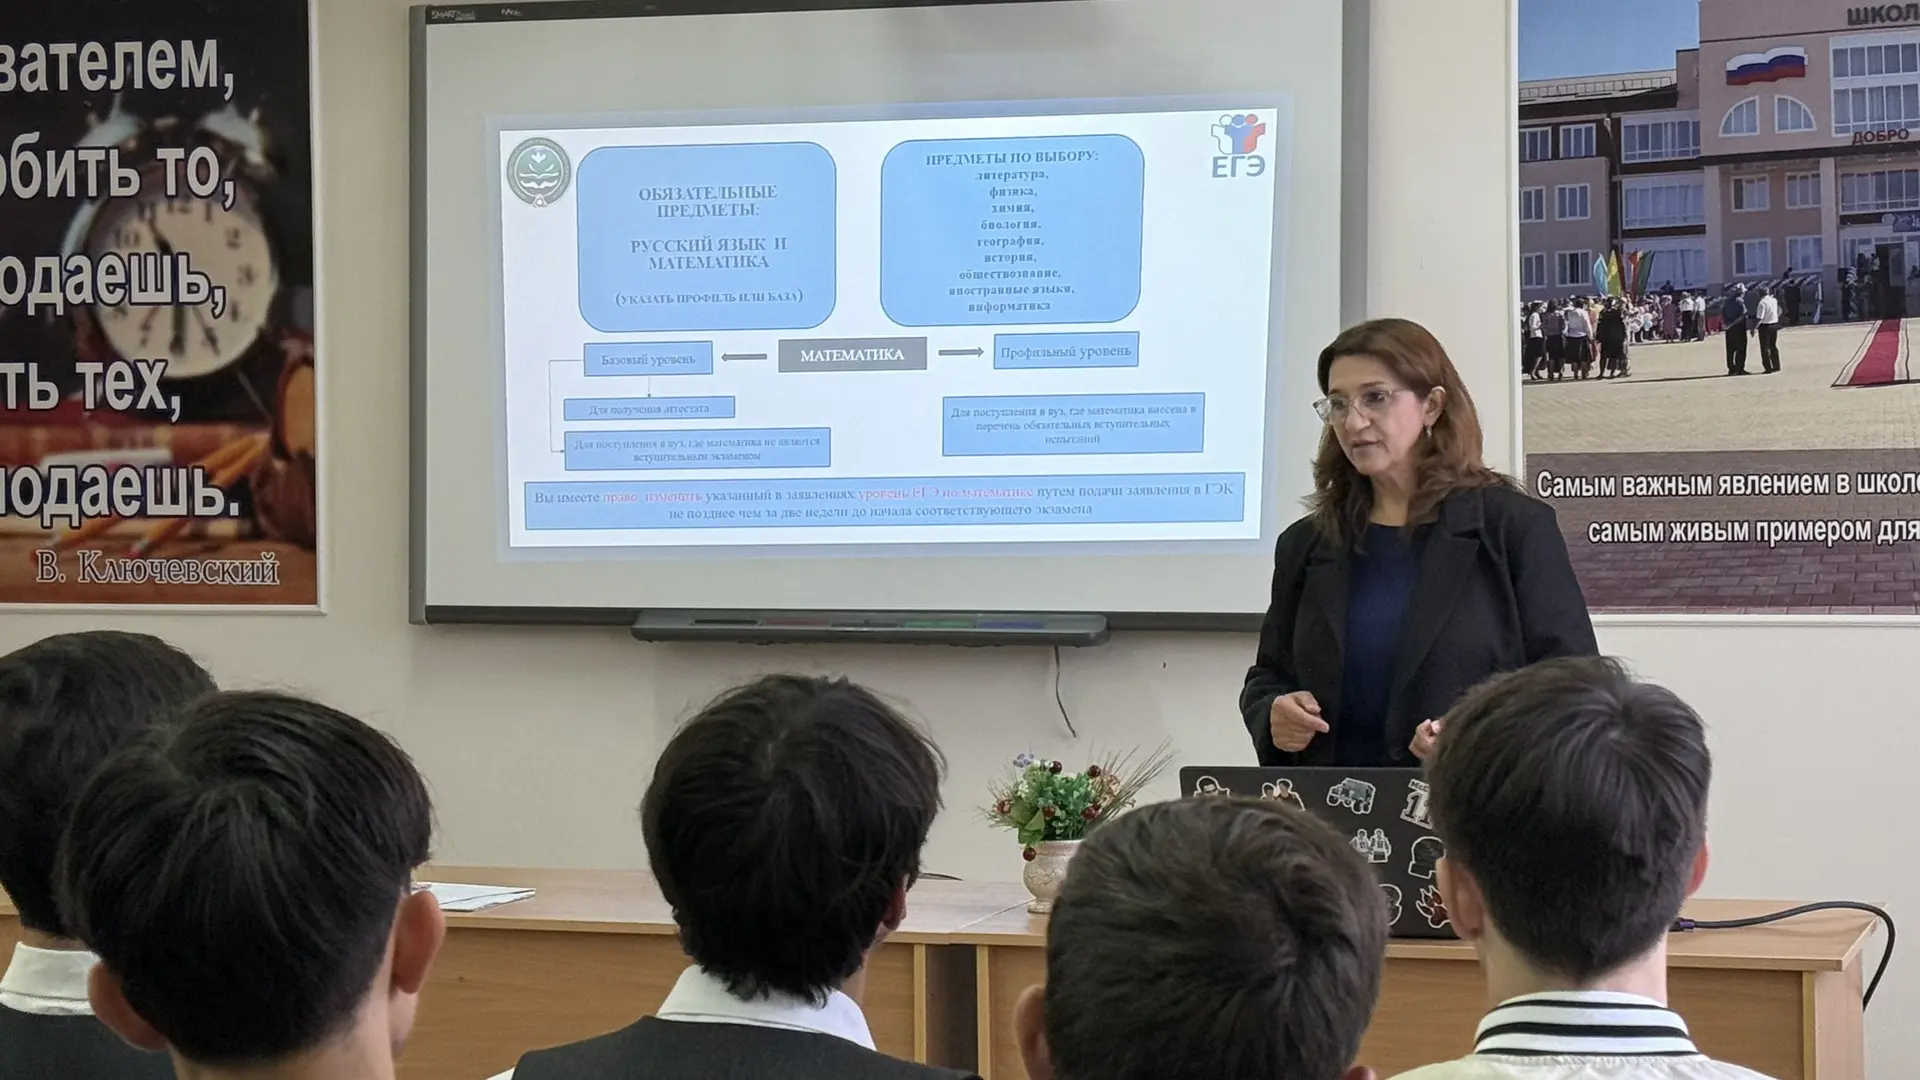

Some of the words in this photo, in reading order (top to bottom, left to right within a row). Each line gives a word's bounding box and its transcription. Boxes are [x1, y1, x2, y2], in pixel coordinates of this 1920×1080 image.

[1847, 3, 1920, 26] ШКОЛ
[1852, 128, 1910, 145] ДОБРО
[926, 153, 1007, 166] ПРЕДМЕТЫ
[1010, 152, 1032, 164] ПО
[1035, 151, 1099, 163] ВЫБОРУ:
[0, 131, 141, 199] бить
[156, 146, 236, 210] то,
[1212, 155, 1266, 178] ЕГЭ
[975, 169, 1049, 182] литература,
[638, 185, 778, 201] ОБЯЗАТЕЛЬНЫЕ
[989, 186, 1038, 199] физика,
[656, 204, 760, 219] ПРЕДМЕТЫ:
[991, 203, 1035, 214] химия,
[631, 236, 713, 253] РУССКИЙ
[718, 237, 766, 252] ЯЗЫК
[774, 237, 788, 250] И
[649, 255, 770, 270] МАТЕМАТИКА
[984, 252, 1037, 264] история,
[959, 268, 1062, 280] обществознание,
[0, 253, 226, 317] одаешь,
[948, 285, 1030, 298] иностранные
[1032, 284, 1075, 295] языки,
[615, 292, 674, 307] (УКАЗАТЬ
[677, 293, 737, 305] ПРОФИЛЬ
[739, 292, 766, 302] ИЛИ
[768, 289, 803, 303] БАЗА)
[968, 302, 1051, 314] информатика
[601, 353, 649, 366] Базовый
[650, 355, 697, 367] уровень
[800, 348, 905, 362] МАТЕМАТИКА
[1001, 345, 1076, 360] Профильный
[1079, 346, 1132, 360] уровень
[0, 362, 60, 410] ть
[76, 360, 181, 422] тех,
[588, 405, 608, 416] Для
[610, 405, 661, 416] получения
[664, 403, 710, 413] аттестата
[951, 408, 970, 418] Для
[973, 408, 1037, 419] поступления
[1087, 407, 1145, 415] математика
[976, 422, 1022, 432] перечень
[1023, 420, 1092, 431] обязательных
[1094, 420, 1171, 431] вступительных
[574, 440, 594, 450] Для
[596, 440, 657, 451] поступления
[1536, 471, 1616, 497] Самым
[1623, 474, 1712, 496] важным
[1718, 473, 1830, 496] явлением
[1836, 473, 1851, 494] в
[1857, 472, 1920, 494] школ
[0, 466, 239, 527] одаешь.
[535, 492, 554, 503] Вы
[556, 493, 600, 503] имеете
[603, 493, 638, 505] право
[645, 491, 701, 502] изменить
[705, 489, 772, 503] указанный
[775, 490, 782, 500] в
[786, 489, 855, 500] заявлениях
[912, 487, 939, 498] ЕГЭ
[942, 489, 958, 498] по
[961, 487, 1033, 498] математике
[1037, 486, 1075, 500] путем
[1079, 486, 1123, 498] подачи
[1127, 484, 1190, 496] заявления
[1194, 485, 1201, 494] в
[1204, 483, 1234, 494] ГЭК
[669, 510, 684, 519] не
[686, 510, 735, 520] позднее
[739, 510, 761, 518] чем
[765, 509, 777, 518] за
[780, 509, 801, 518] две
[805, 508, 848, 518] недели
[852, 508, 867, 518] до
[870, 507, 912, 517] начала
[915, 505, 1033, 518] соответствующего
[1035, 504, 1093, 515] экзамена
[1588, 521, 1664, 543] самым
[1670, 520, 1749, 542] живым
[1756, 520, 1872, 547] примером
[1877, 520, 1920, 545] для
[36, 550, 66, 582] В.
[77, 551, 280, 585] Ключевский
